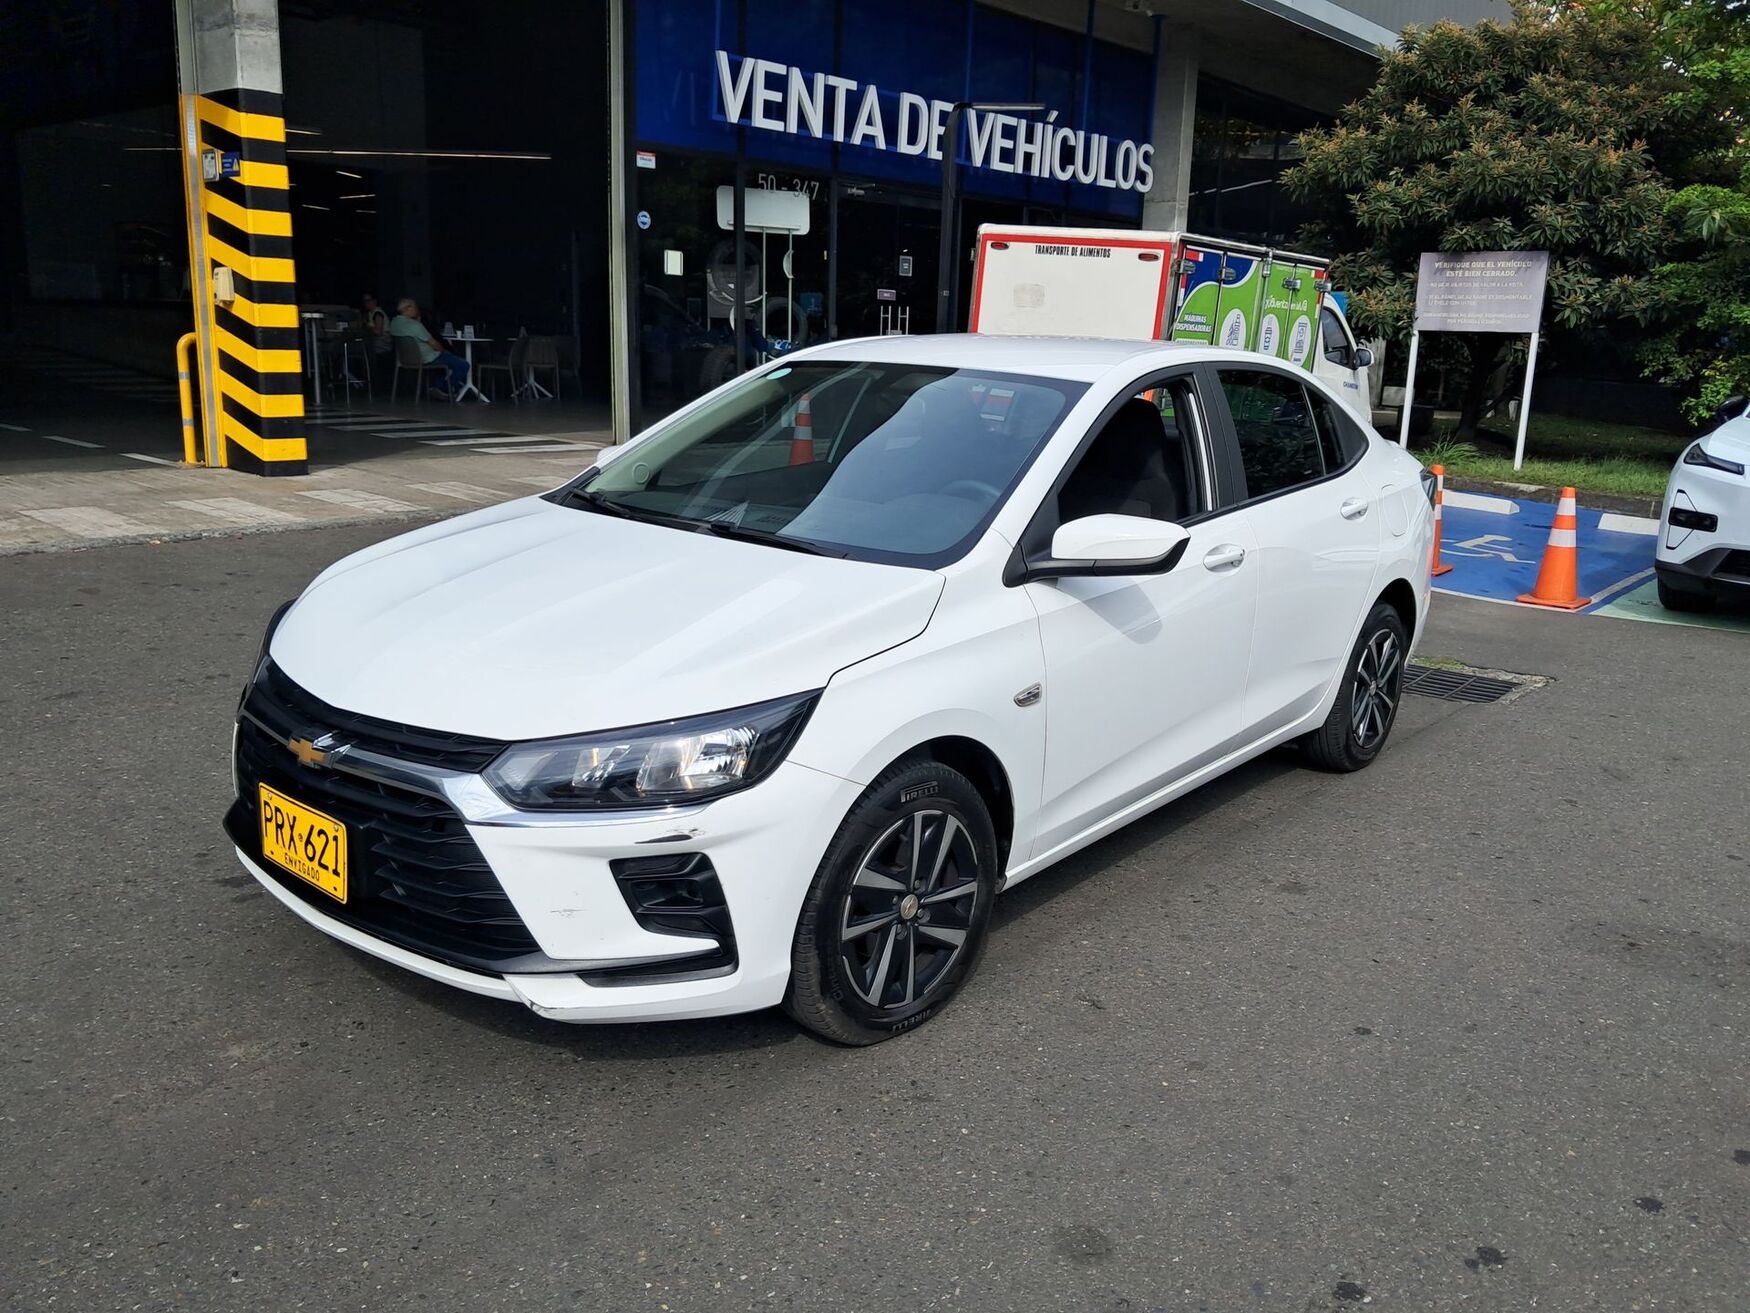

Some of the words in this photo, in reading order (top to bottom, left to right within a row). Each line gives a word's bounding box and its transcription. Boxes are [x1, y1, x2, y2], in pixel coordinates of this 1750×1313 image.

[715, 50, 886, 150] VENTA
[897, 92, 953, 161] DE
[966, 108, 1155, 194] VEHÍCULOS
[758, 172, 777, 194] 50
[792, 178, 820, 200] 347
[1035, 244, 1070, 256] TRANSPORTE
[1071, 246, 1079, 257] DE
[1079, 247, 1112, 258] ALIMENTOS
[1434, 261, 1470, 269] VERIFIQUE
[1497, 259, 1532, 268] VEHÍCULO
[1446, 269, 1463, 277] ESTÉ
[900, 780, 938, 803] PIRELLI
[263, 799, 298, 855] PRX
[304, 824, 341, 878] 621
[284, 852, 320, 881] ENVIGADO
